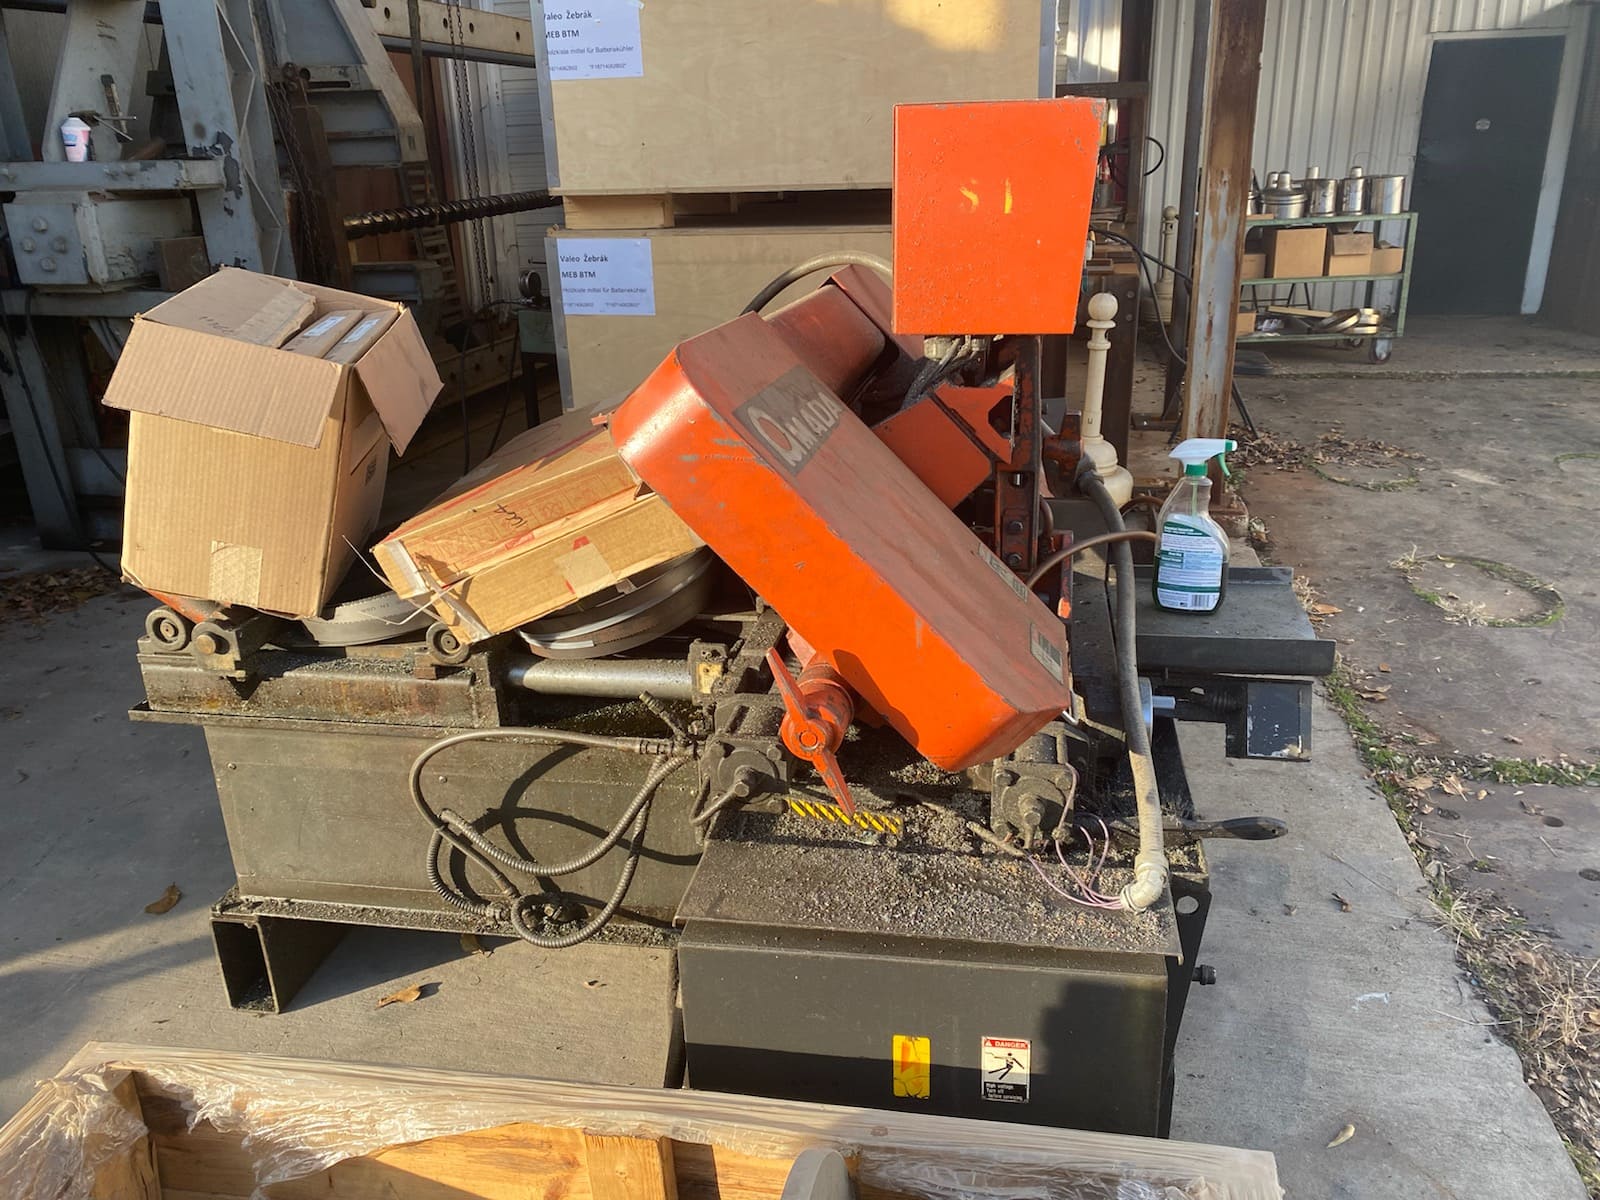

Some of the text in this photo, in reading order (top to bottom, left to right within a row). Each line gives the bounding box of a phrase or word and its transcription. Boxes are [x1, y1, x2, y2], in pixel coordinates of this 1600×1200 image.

[566, 9, 592, 20] Žebrák
[562, 29, 580, 38] BTM
[560, 253, 609, 263] Valeo Žebrák
[561, 271, 596, 279] MEB BTM
[994, 1041, 1026, 1049] DANGER
